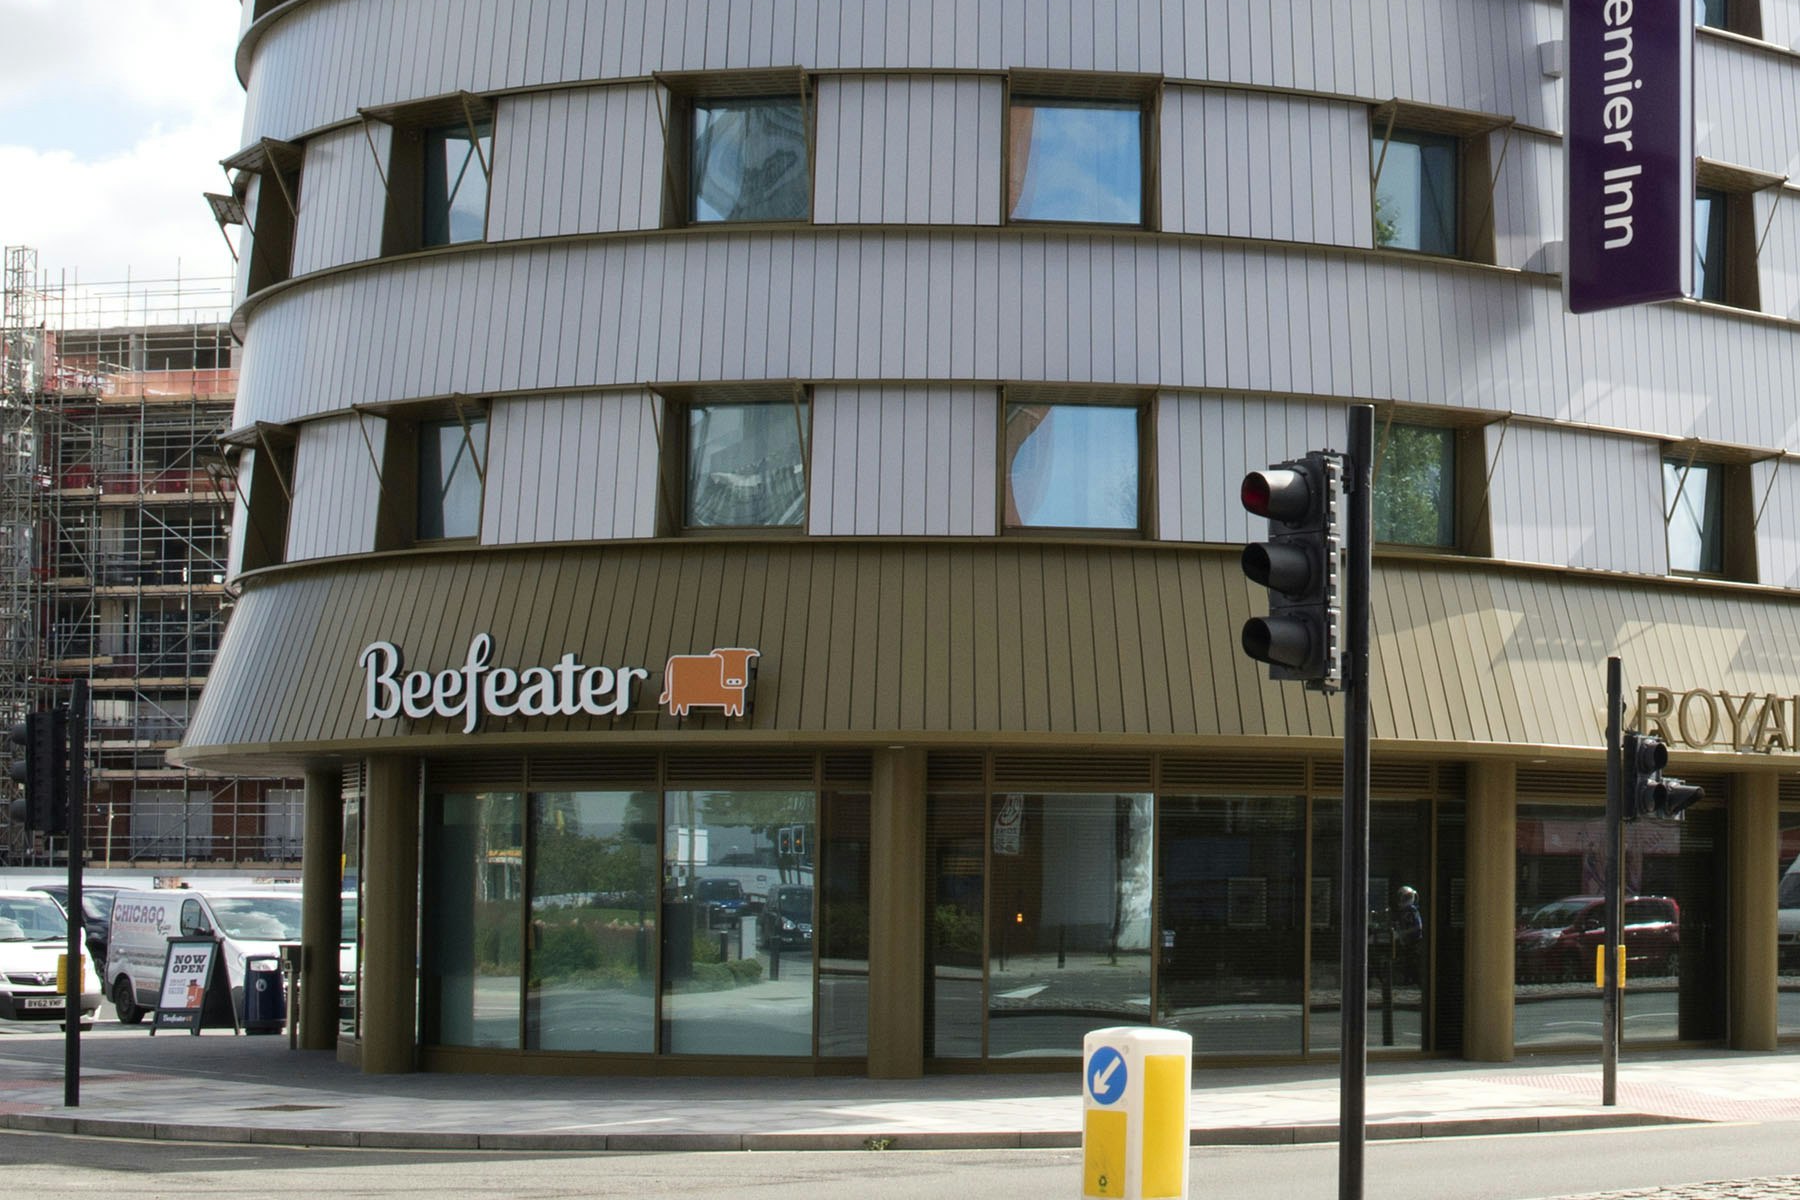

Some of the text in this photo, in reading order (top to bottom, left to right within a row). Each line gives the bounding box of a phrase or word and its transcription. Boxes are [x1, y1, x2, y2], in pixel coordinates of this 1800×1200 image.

[1603, 164, 1642, 250] Inn
[359, 632, 648, 734] Beefeater
[115, 904, 165, 923] CHICAGO
[172, 964, 205, 974] OPEN
[174, 954, 207, 965] NOW
